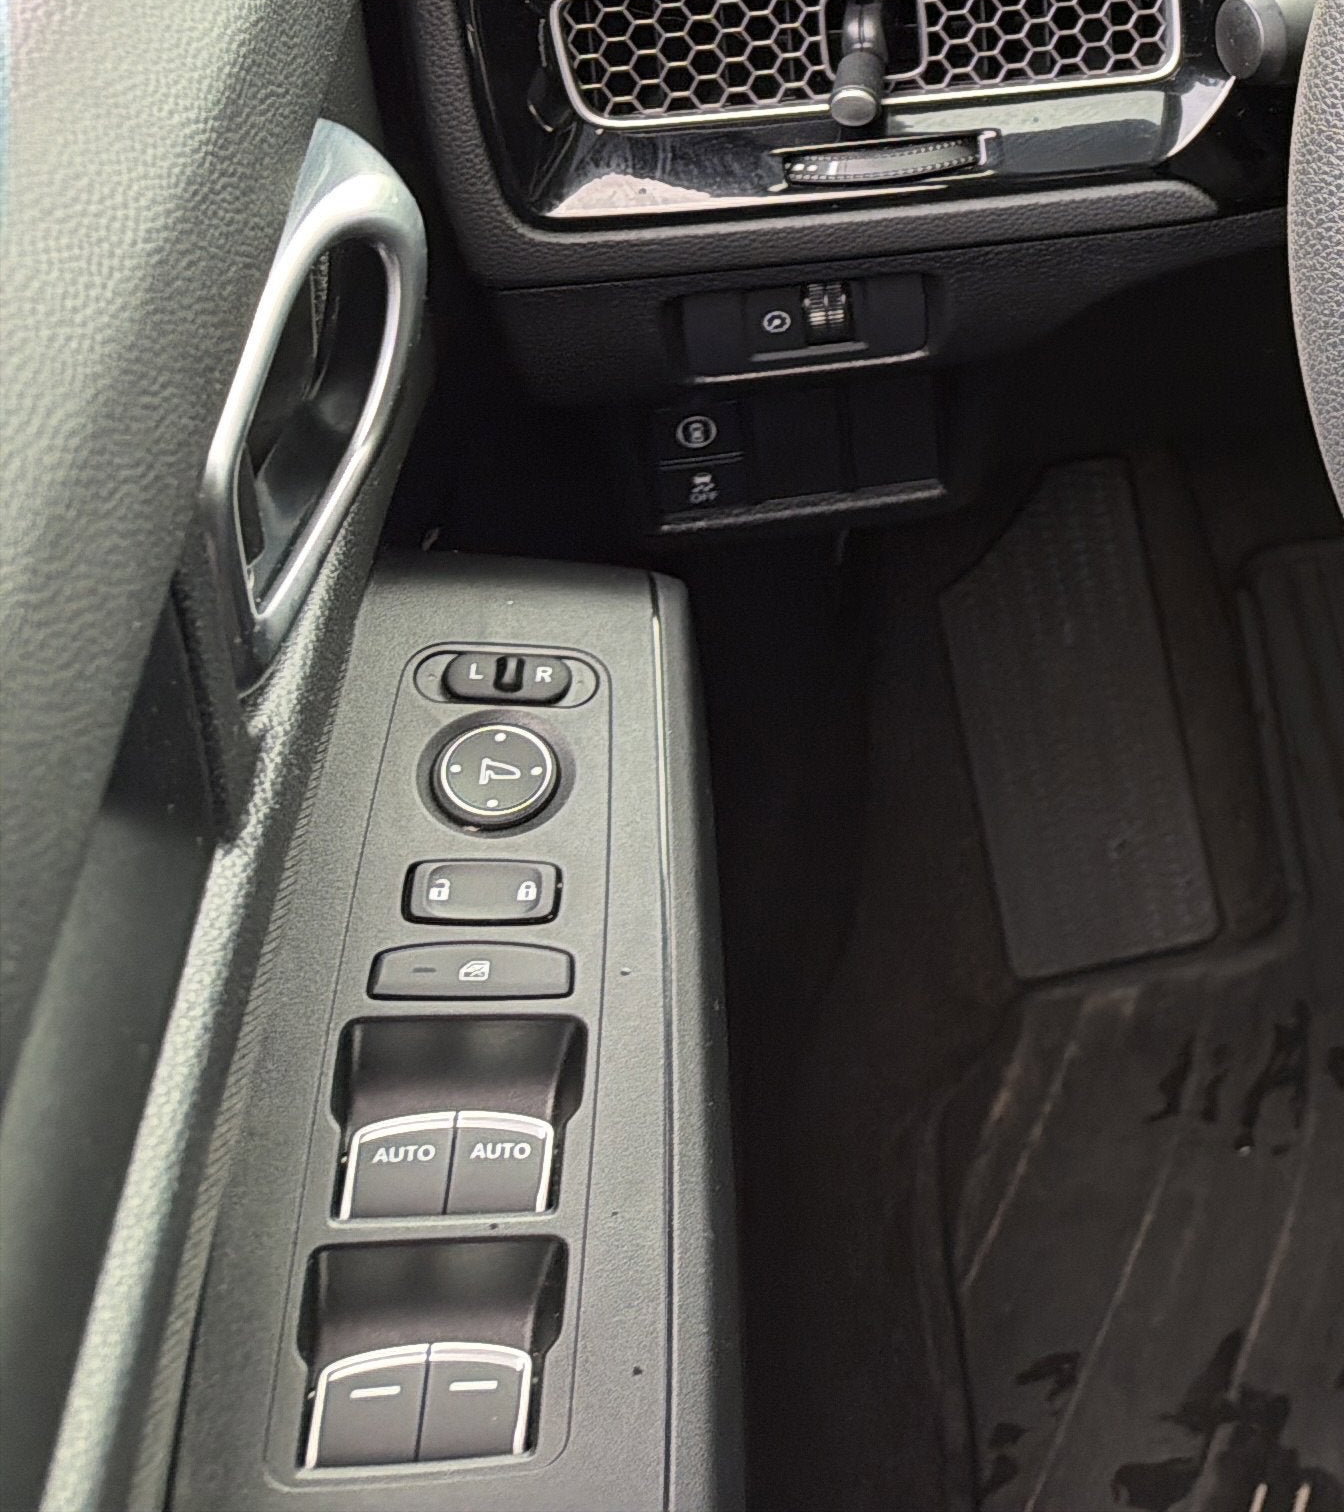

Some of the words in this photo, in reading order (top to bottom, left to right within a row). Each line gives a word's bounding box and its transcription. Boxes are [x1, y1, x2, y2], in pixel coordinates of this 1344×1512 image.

[689, 489, 719, 505] OFF
[468, 662, 484, 680] L
[534, 665, 553, 683] R
[371, 1143, 437, 1164] AUTO
[468, 1142, 532, 1161] AUTO
